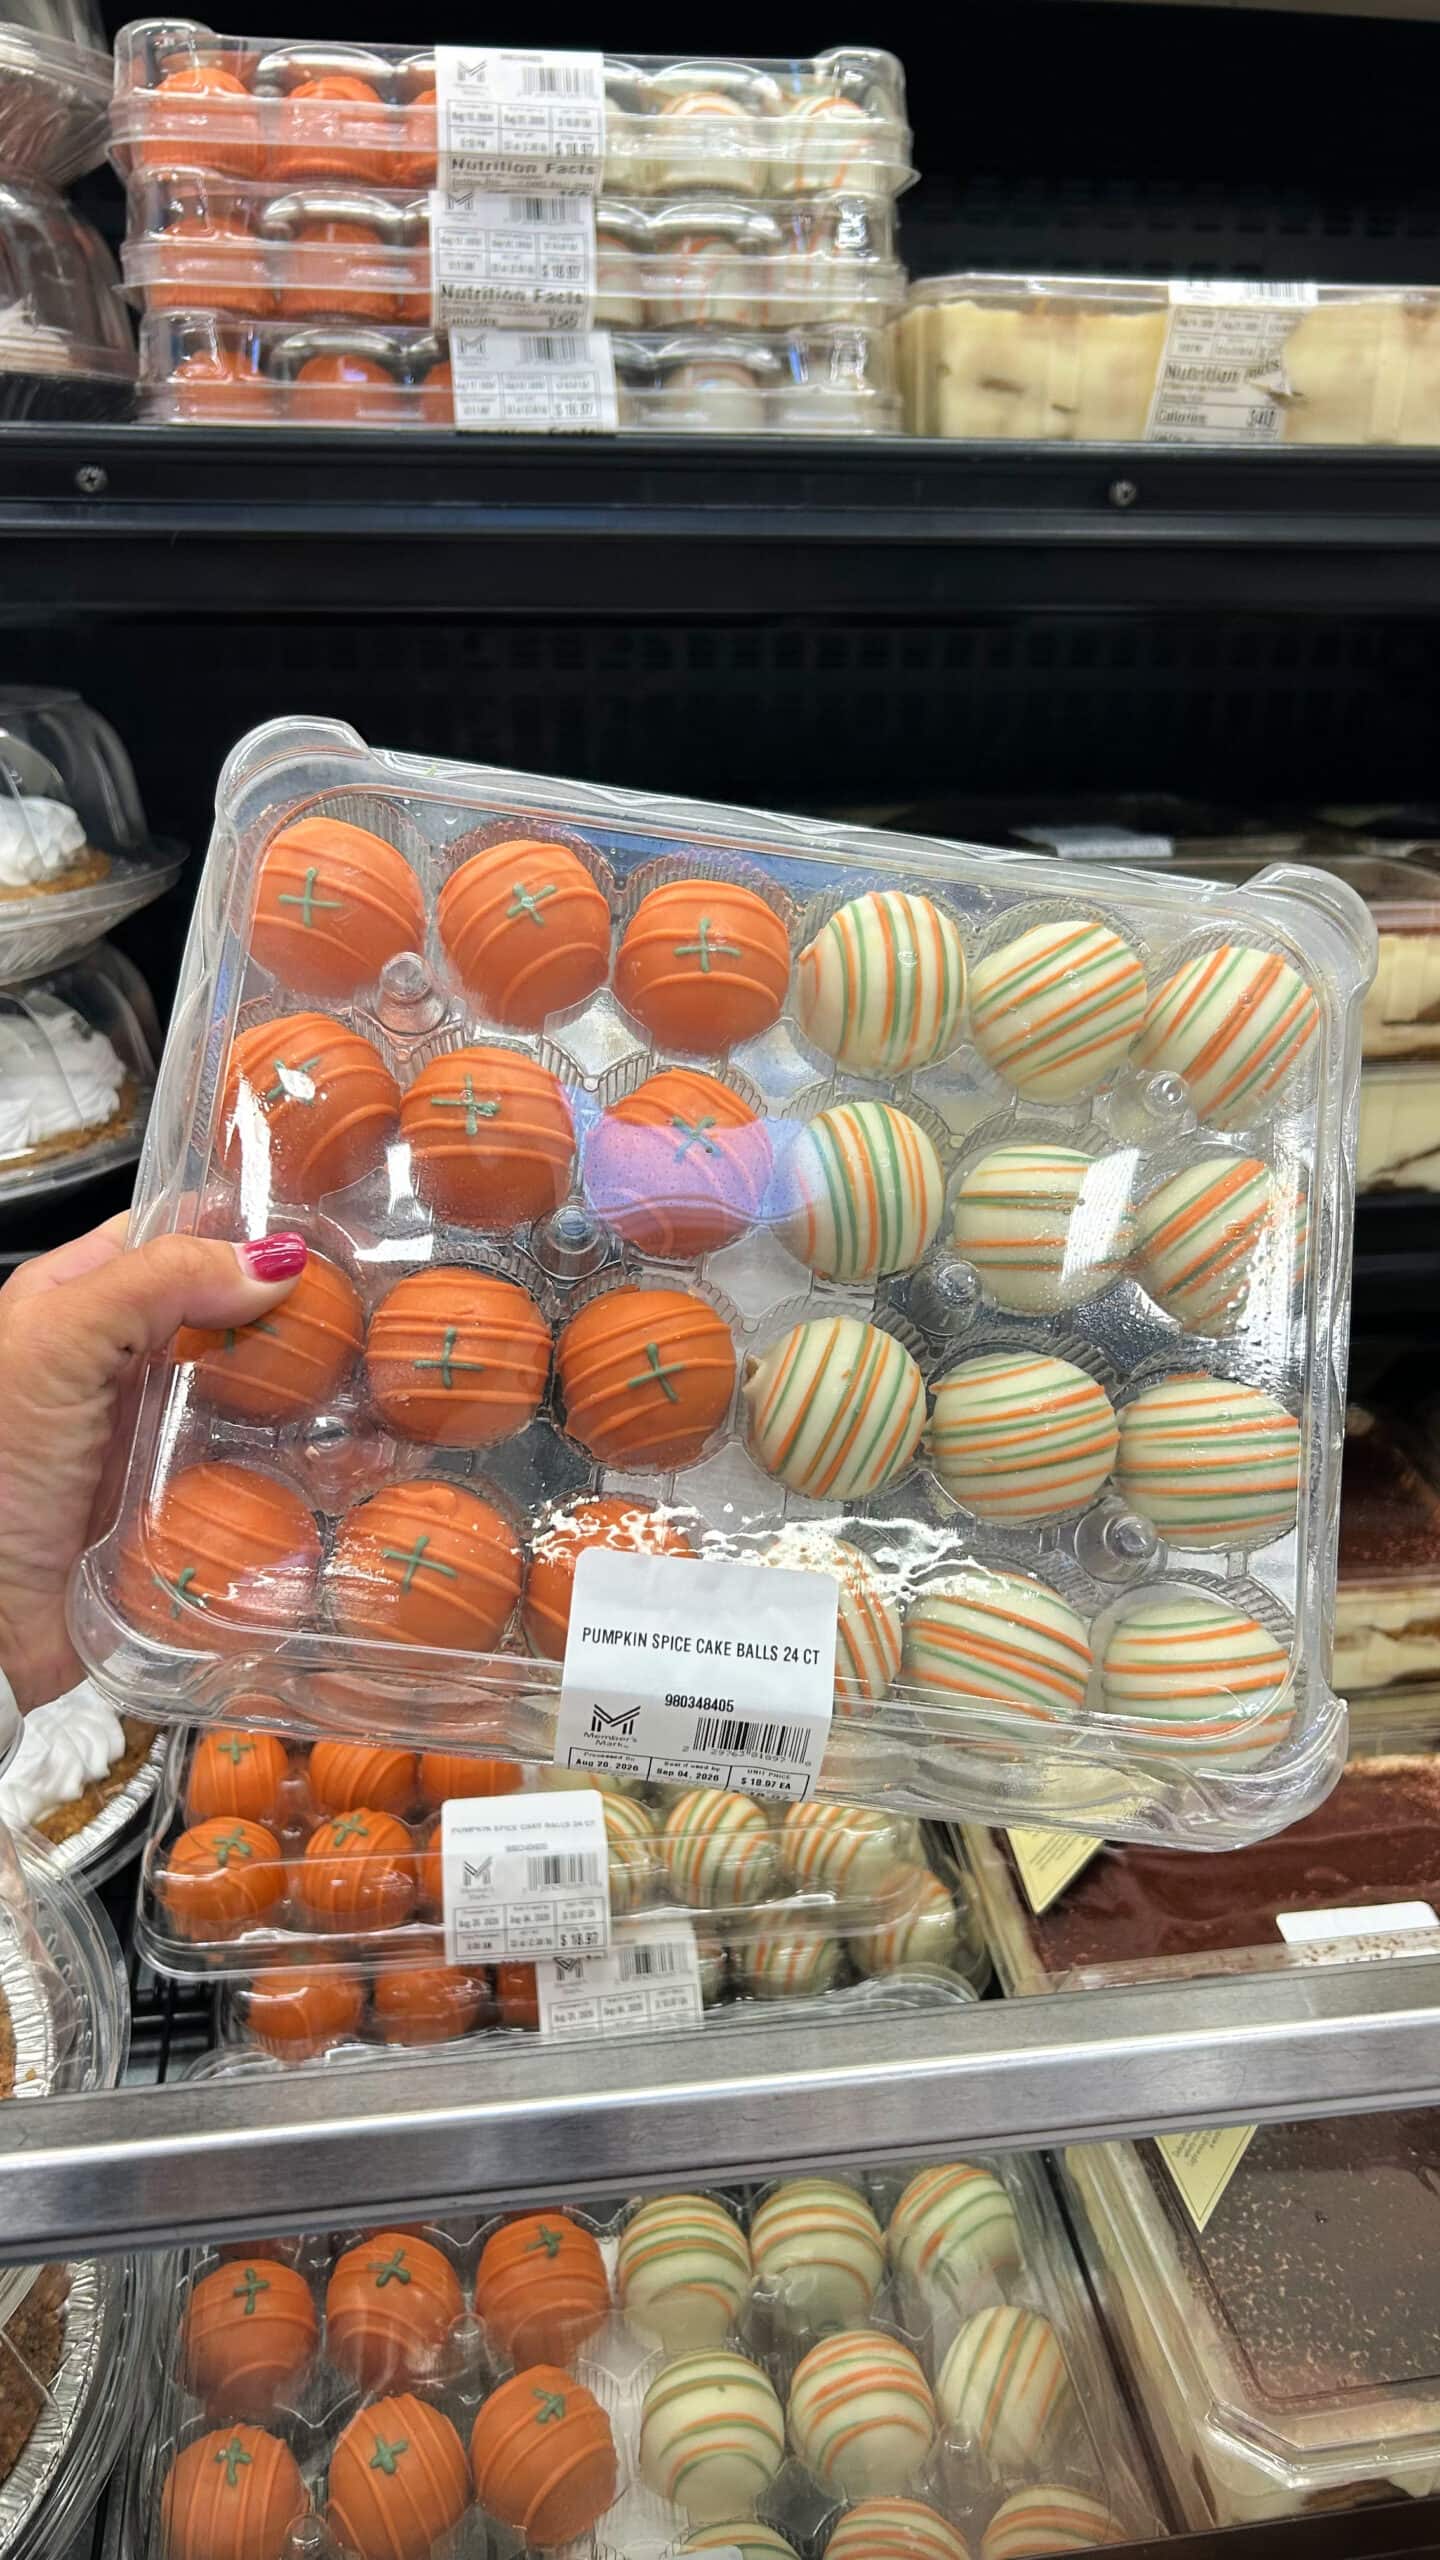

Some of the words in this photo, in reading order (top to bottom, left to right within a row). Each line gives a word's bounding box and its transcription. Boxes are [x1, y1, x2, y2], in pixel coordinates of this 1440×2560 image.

[451, 158, 537, 174] Nutrition
[545, 163, 595, 175] Facts
[440, 284, 526, 301] Nutrition
[534, 288, 583, 304] Facts
[1166, 364, 1238, 383] Nutrition
[582, 1627, 648, 1648] PUMPKIN
[652, 1633, 692, 1653] SPICE
[696, 1638, 732, 1657] CAKE
[736, 1643, 779, 1662] BALLS
[783, 1646, 799, 1663] 24
[803, 1649, 820, 1665] CT
[664, 1693, 735, 1713] 980348405
[583, 1731, 637, 1743] Member's
[576, 1758, 594, 1767] Aug
[656, 1767, 674, 1777] Sep
[779, 1782, 791, 1790] EA
